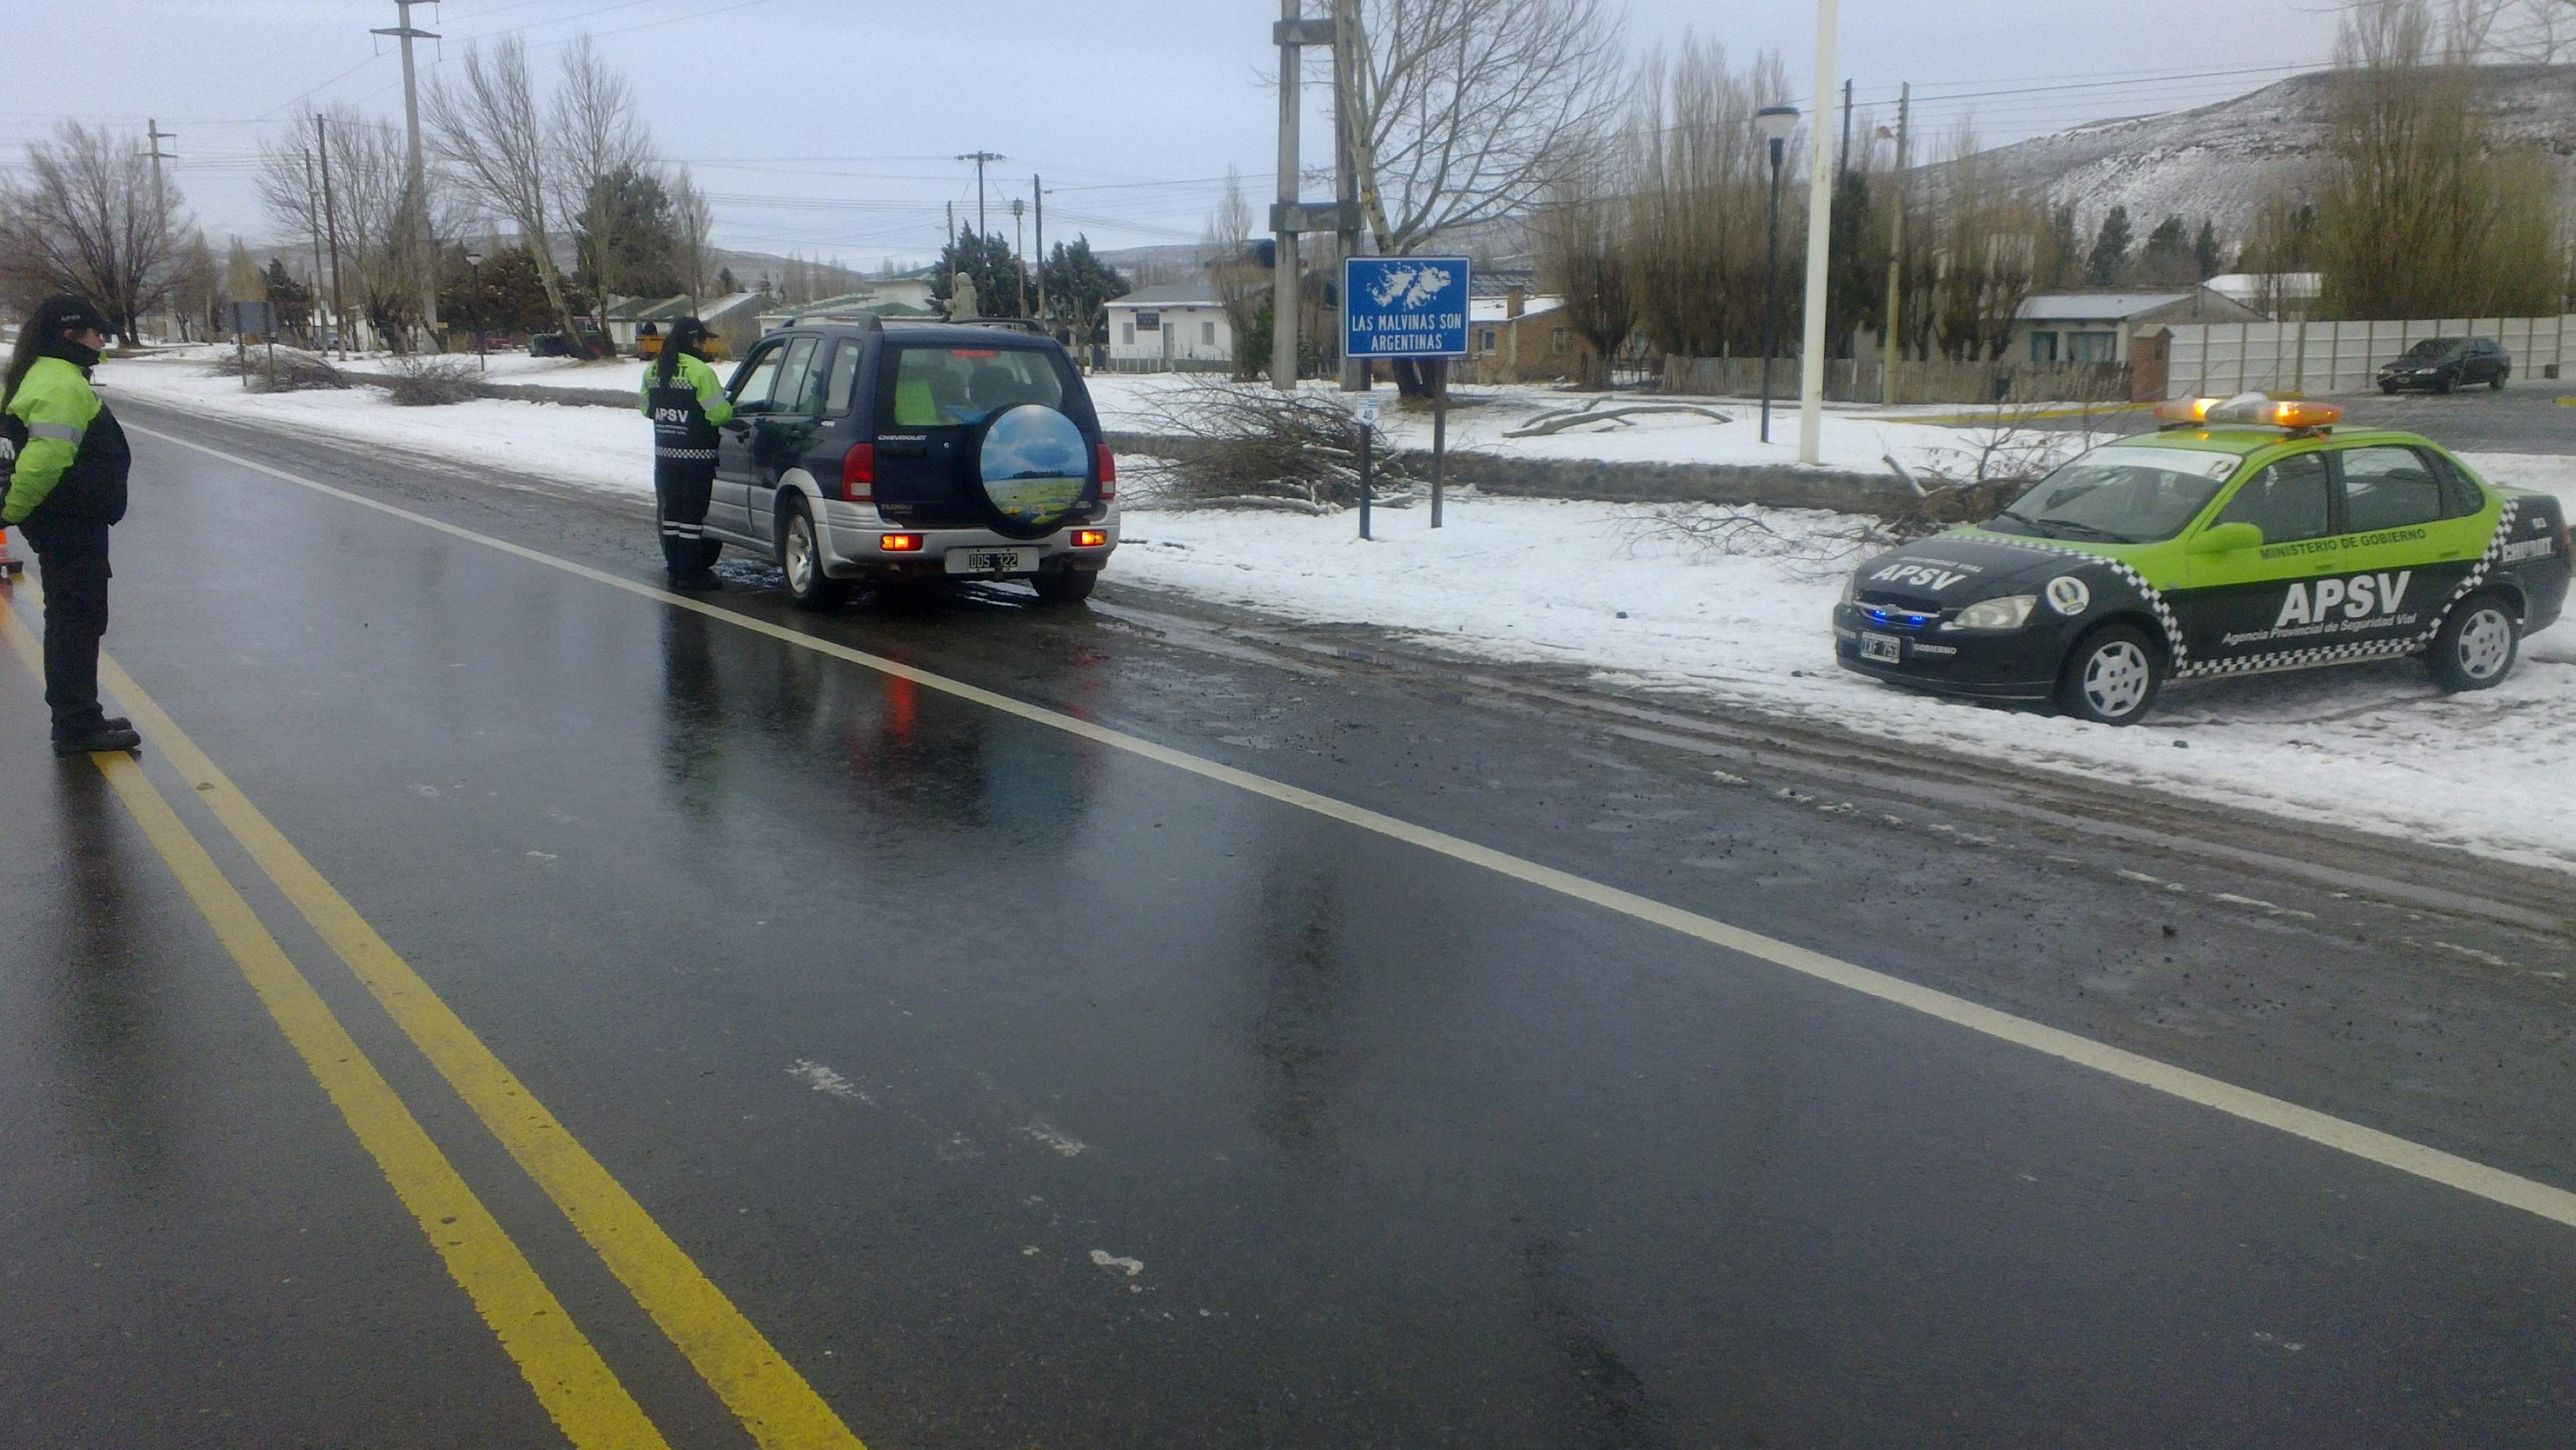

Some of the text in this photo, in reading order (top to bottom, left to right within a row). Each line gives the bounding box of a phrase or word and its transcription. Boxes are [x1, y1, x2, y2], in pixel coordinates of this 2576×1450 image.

[1353, 313, 1461, 331] LAS MALVINAS SON
[1371, 334, 1442, 351] ARGENTINAS
[655, 407, 688, 422] APSV
[1363, 410, 1373, 420] 40
[2260, 529, 2427, 559] MINISTERIO DE GOBIERNO
[970, 555, 991, 568] DDS
[1870, 564, 1967, 590] APSV
[2274, 571, 2411, 627] APSV
[2222, 613, 2416, 646] Agencia Provincial de Seguridad Vial
